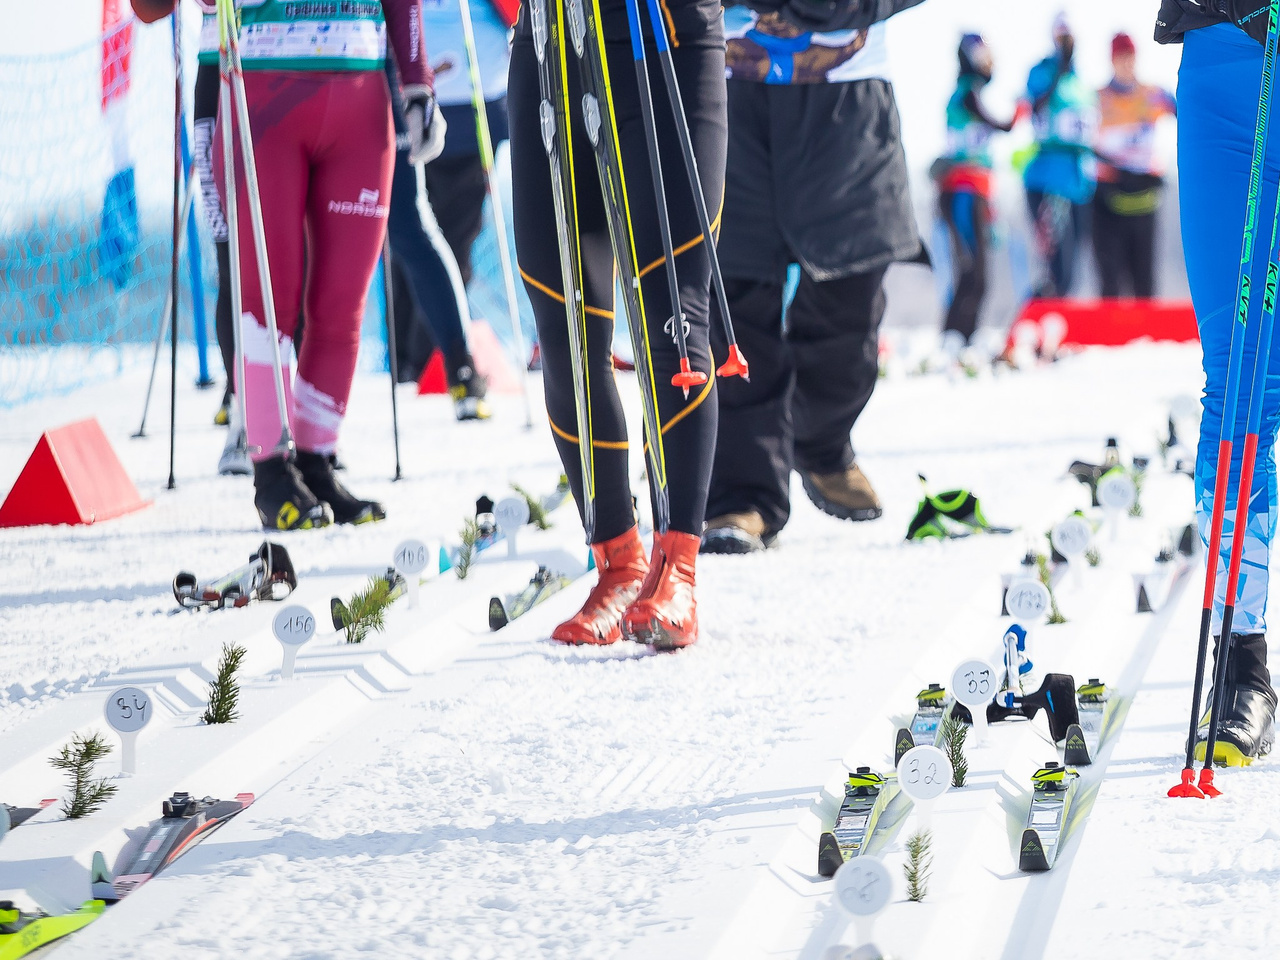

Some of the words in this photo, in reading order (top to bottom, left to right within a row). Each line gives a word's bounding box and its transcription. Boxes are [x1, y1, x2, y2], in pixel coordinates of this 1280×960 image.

[1237, 274, 1252, 327] KV+
[1263, 262, 1279, 315] KV+
[283, 615, 313, 634] 156
[964, 669, 990, 695] 33
[907, 758, 942, 785] 32
